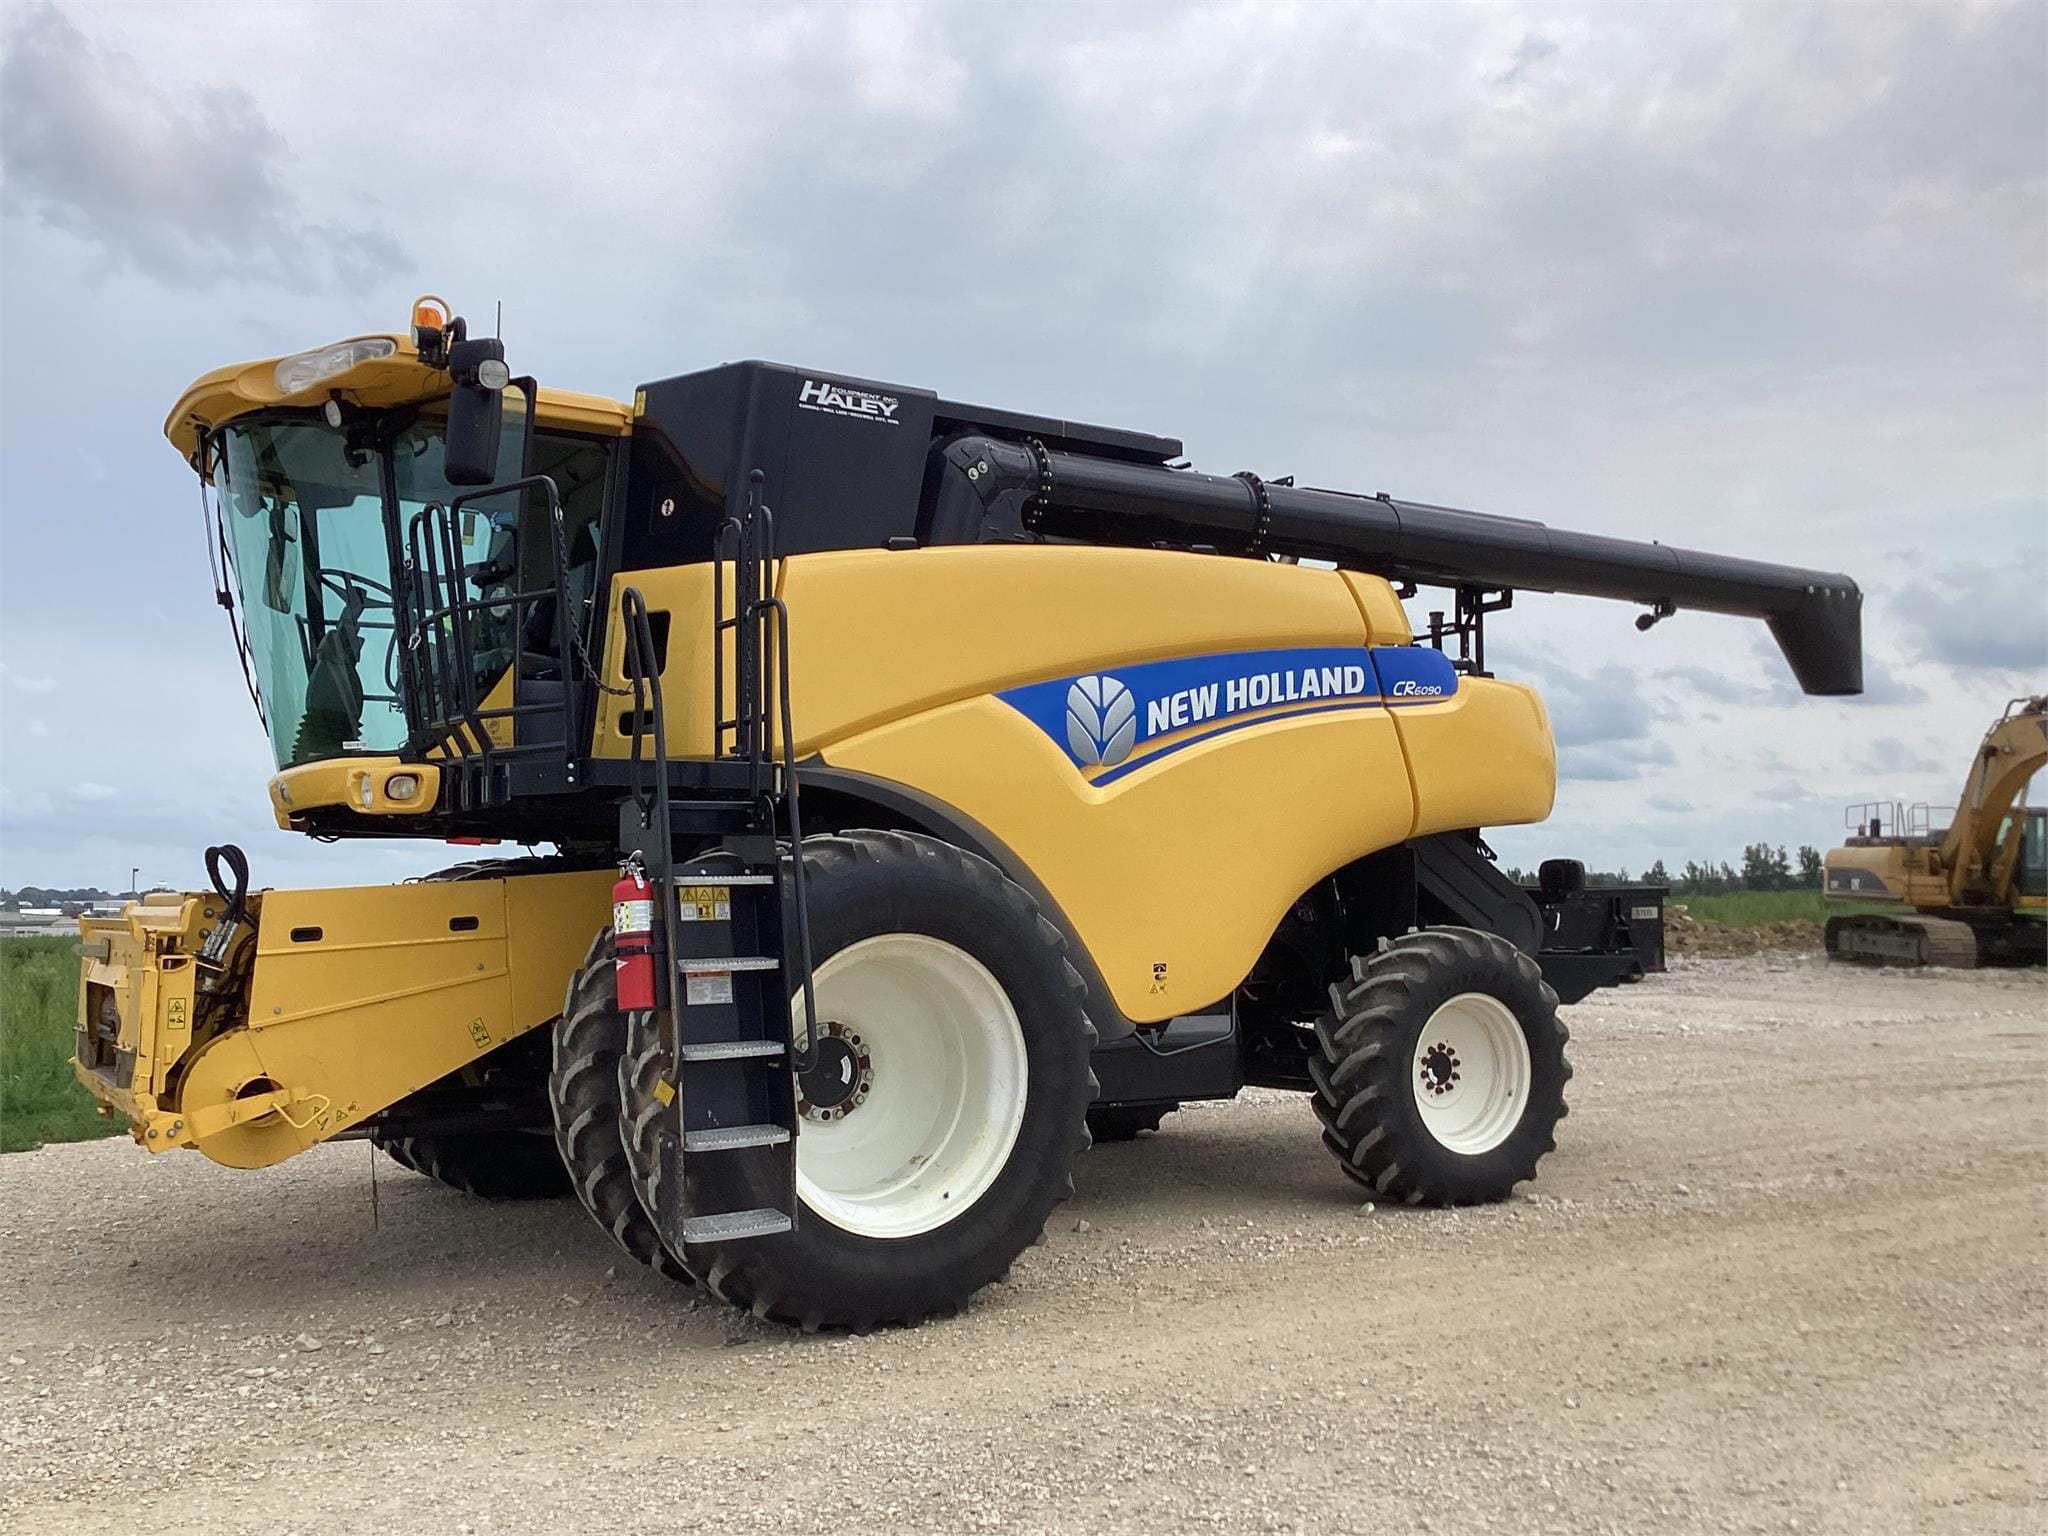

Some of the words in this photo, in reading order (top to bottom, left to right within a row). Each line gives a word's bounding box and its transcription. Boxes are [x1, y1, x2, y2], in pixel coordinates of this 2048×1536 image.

[799, 380, 898, 416] HALEY
[831, 387, 880, 400] EQUIPMENT
[1147, 683, 1219, 736] NEW
[1226, 666, 1364, 712] HOLLAND
